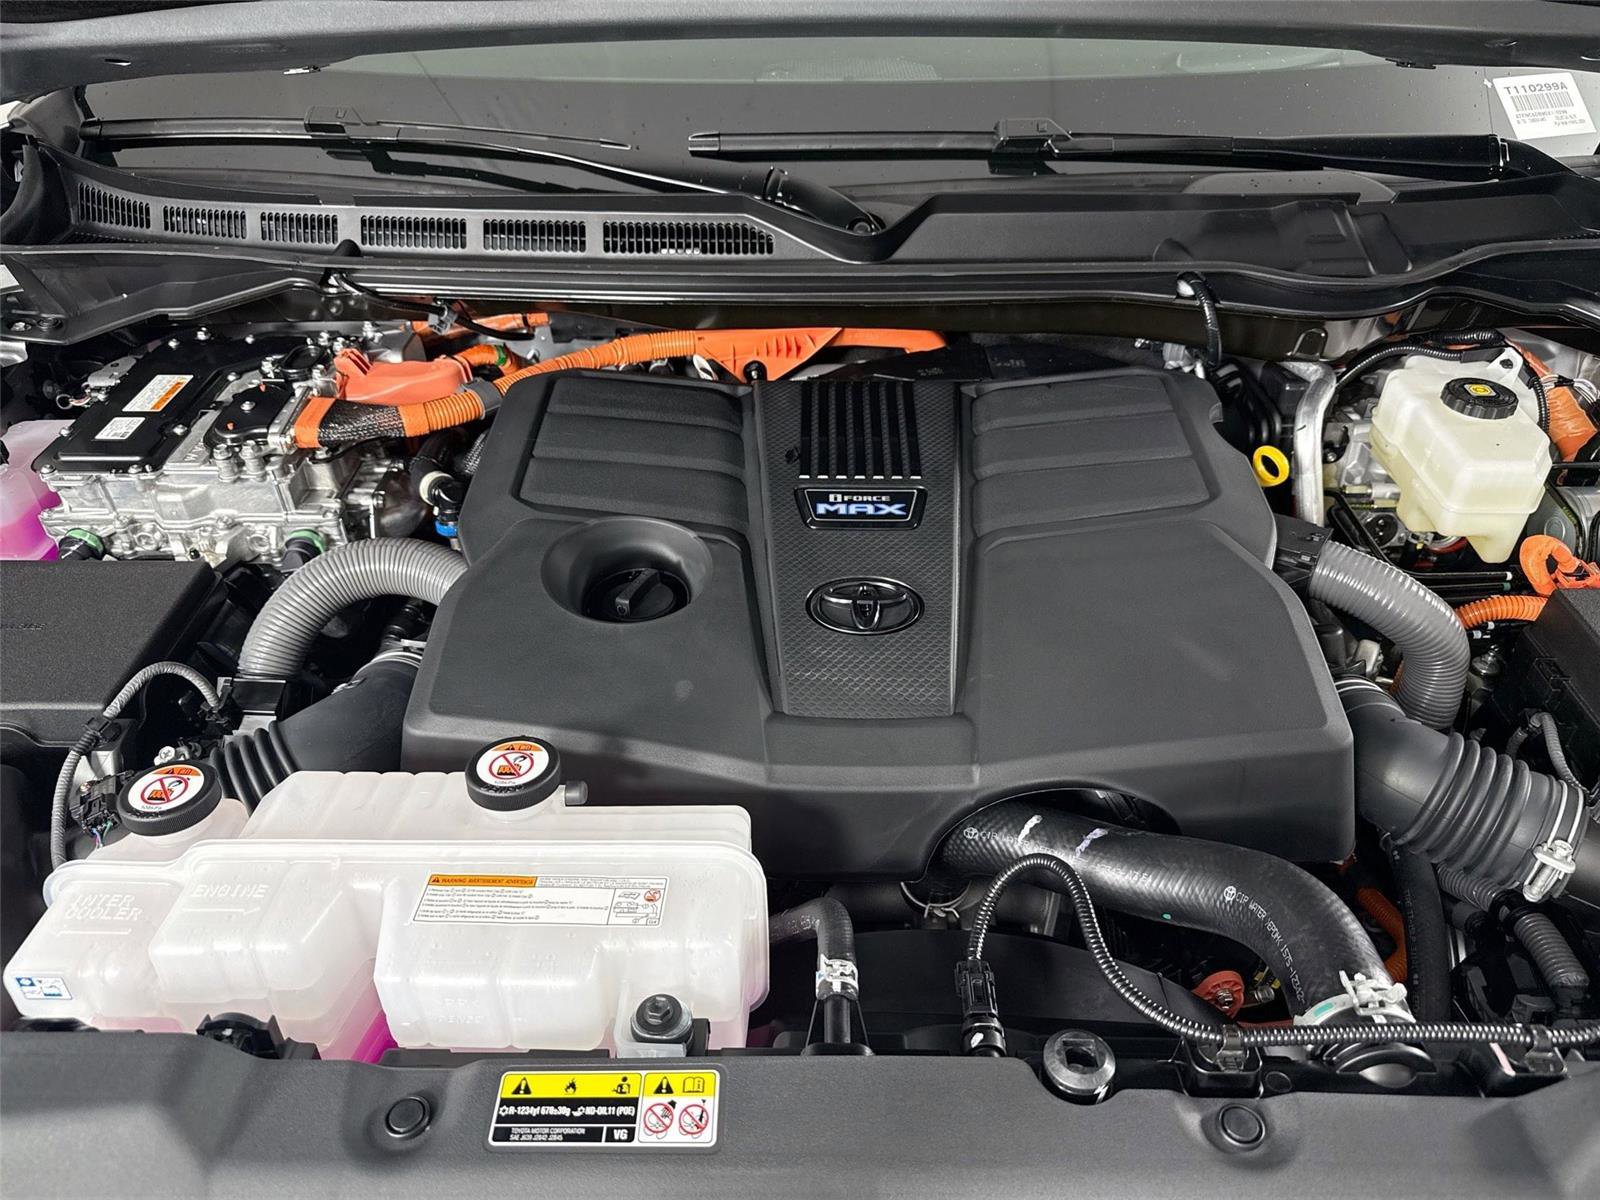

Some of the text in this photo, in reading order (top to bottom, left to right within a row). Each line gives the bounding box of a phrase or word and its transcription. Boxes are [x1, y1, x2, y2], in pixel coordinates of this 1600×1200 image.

[1504, 81, 1568, 95] T110299A
[816, 503, 906, 515] MAX
[191, 884, 270, 898] ENGINE
[74, 894, 135, 907] INTER
[1236, 892, 1249, 903] CIP
[1248, 900, 1267, 920] WATER
[65, 907, 142, 921] COOLER
[617, 1106, 635, 1117] (POE)
